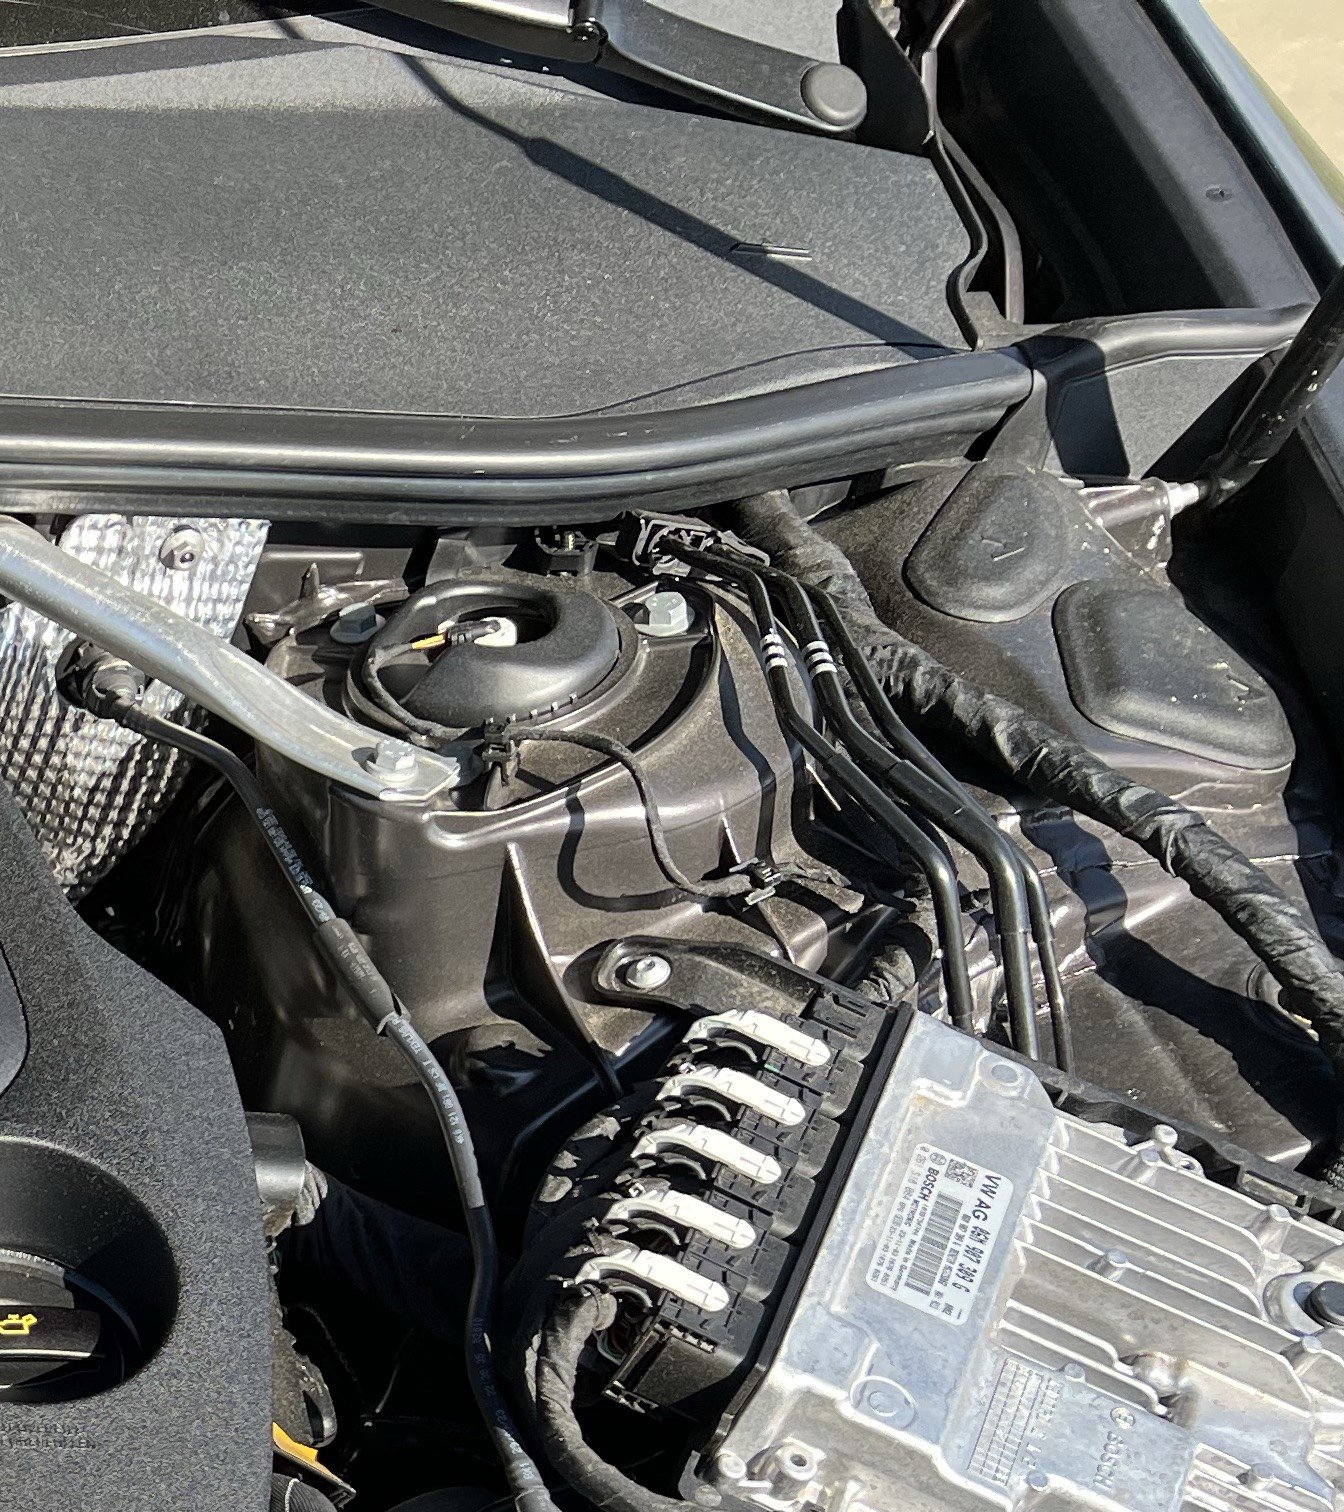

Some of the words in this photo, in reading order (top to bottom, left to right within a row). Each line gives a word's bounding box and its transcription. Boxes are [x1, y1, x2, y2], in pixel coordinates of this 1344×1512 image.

[916, 1166, 940, 1201] BOSCH
[983, 1173, 1001, 1199] VW
[972, 1197, 992, 1222] AG
